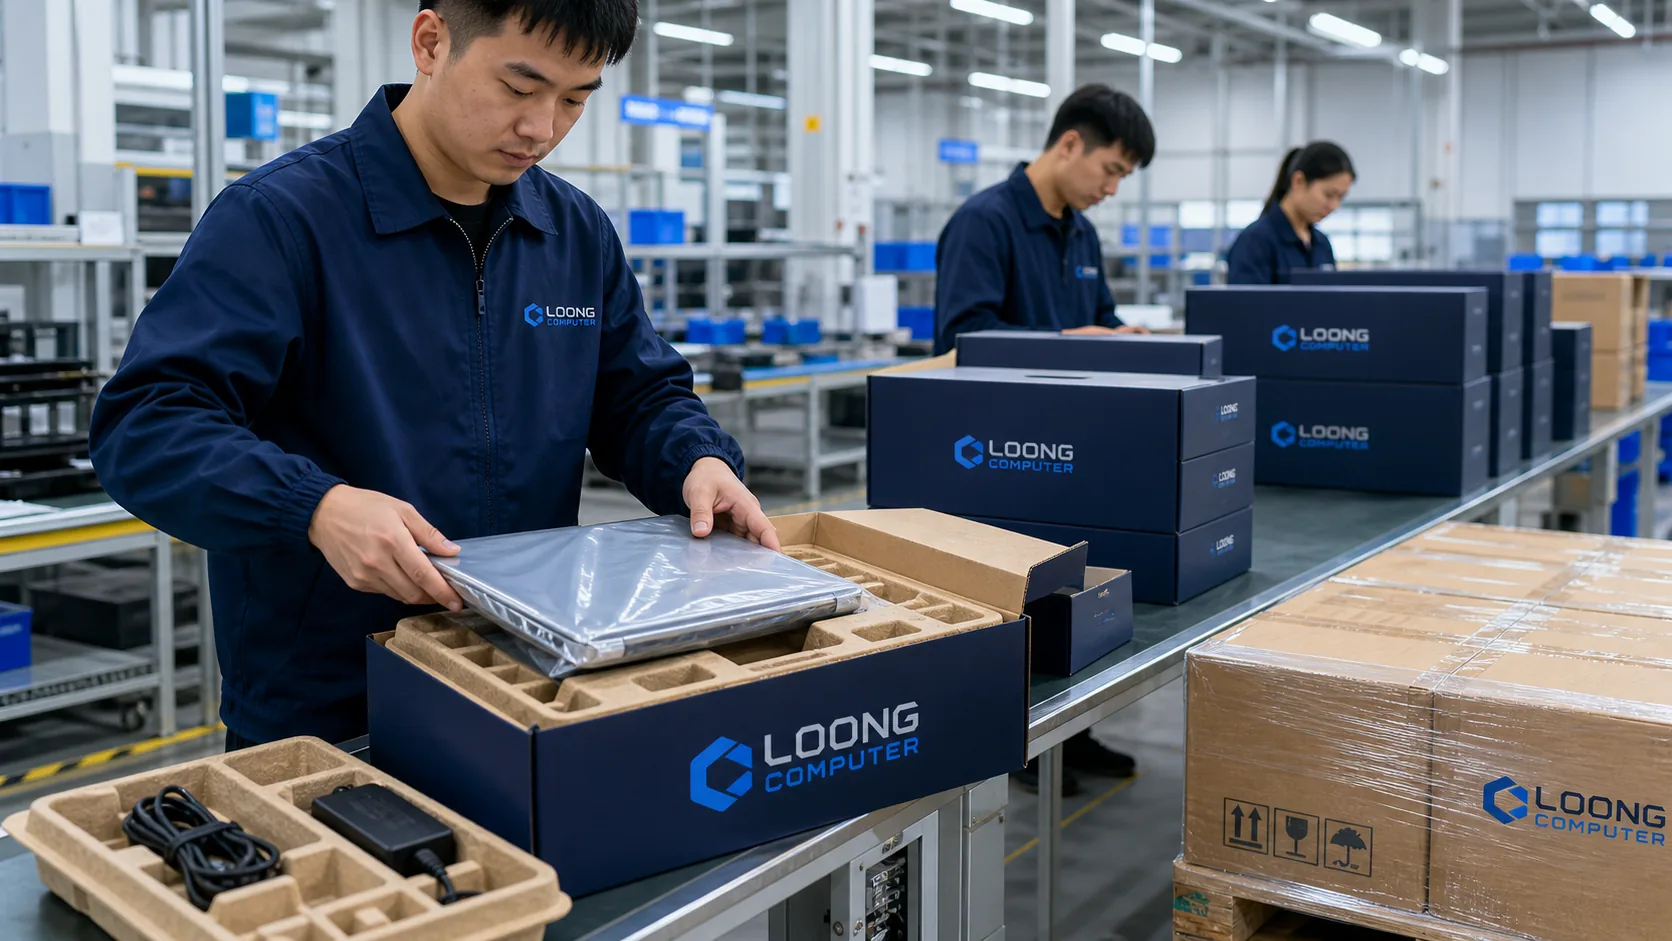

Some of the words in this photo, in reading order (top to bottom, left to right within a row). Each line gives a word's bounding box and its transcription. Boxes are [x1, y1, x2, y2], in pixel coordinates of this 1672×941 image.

[546, 306, 596, 318] LOONG
[547, 318, 596, 326] COMPUTER
[1300, 327, 1370, 342] LOONG
[1298, 424, 1369, 441] LOONG
[988, 439, 1074, 461] LOONG
[988, 458, 1074, 474] COMPUTER
[764, 701, 919, 767] LOONG
[765, 736, 920, 793] COMPUTER
[1535, 786, 1666, 829] LOONG
[1535, 813, 1666, 847] COMPUTER
